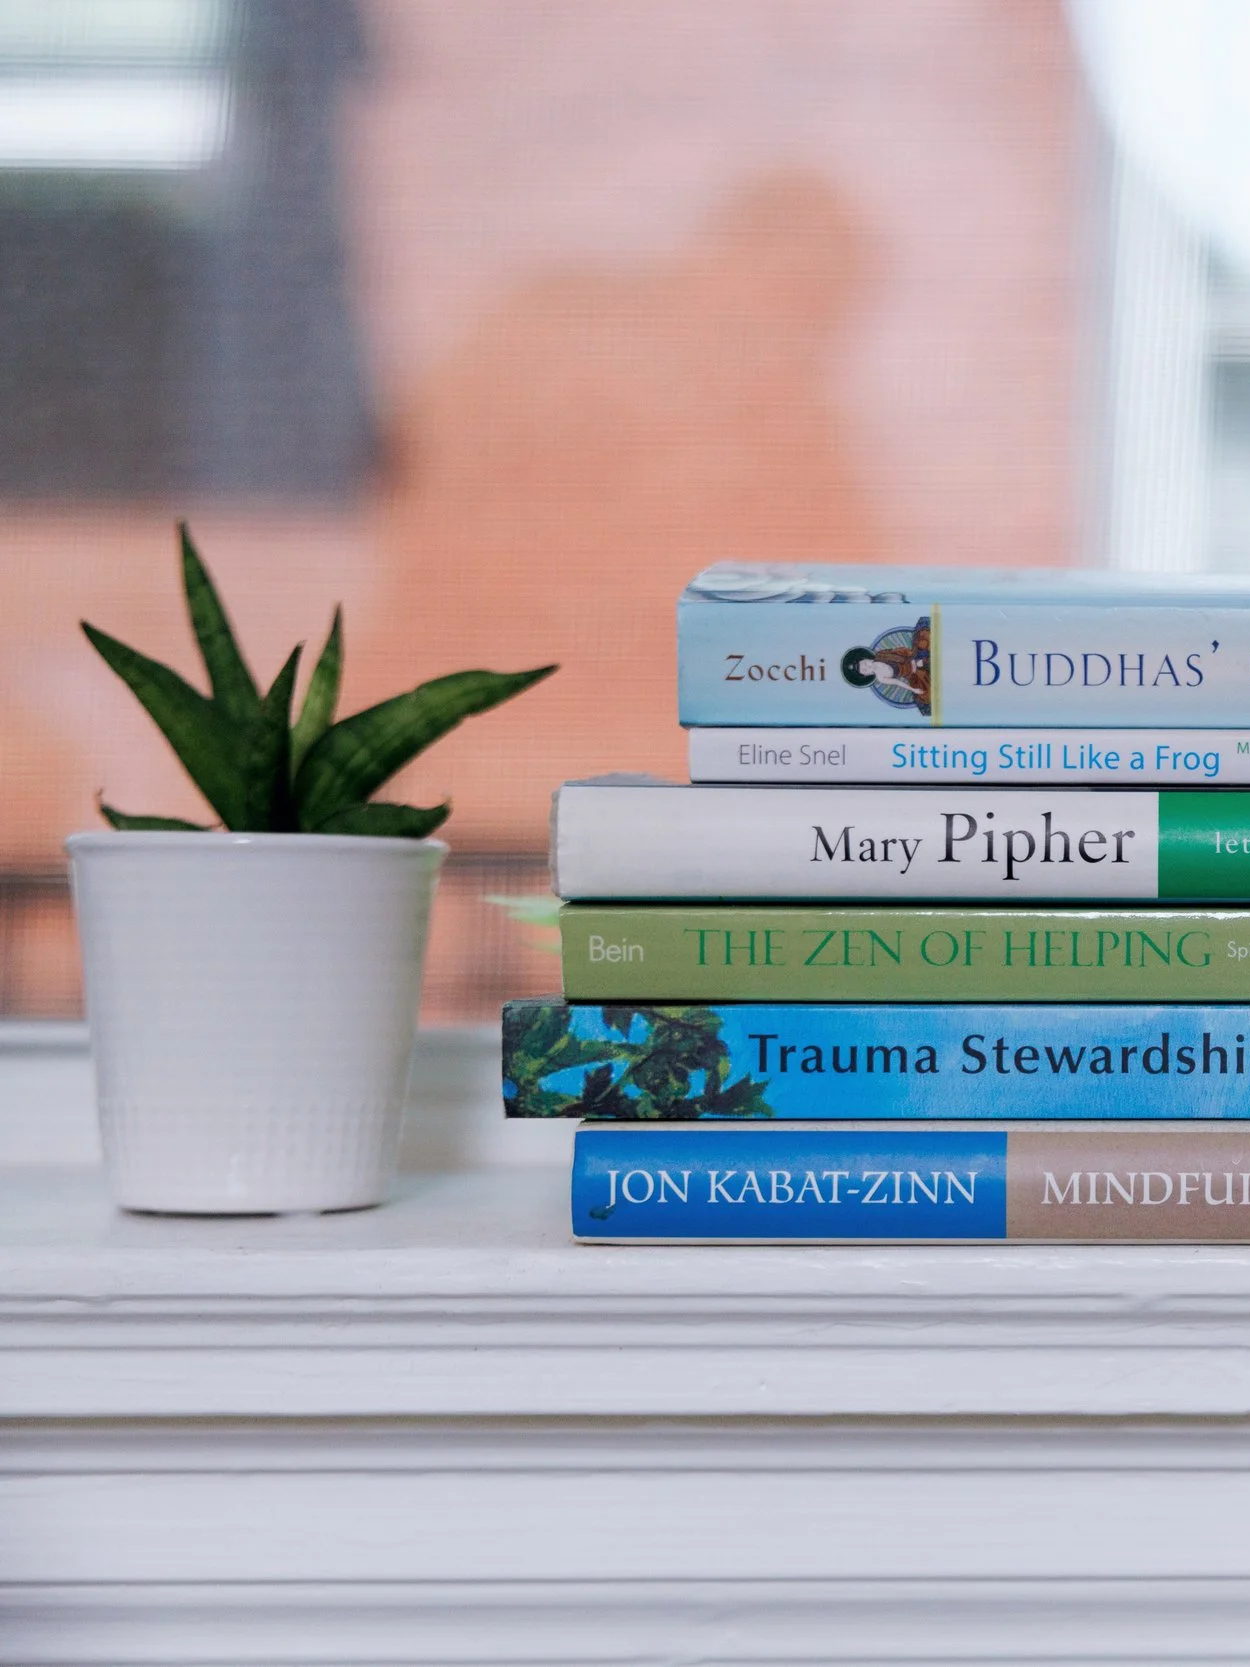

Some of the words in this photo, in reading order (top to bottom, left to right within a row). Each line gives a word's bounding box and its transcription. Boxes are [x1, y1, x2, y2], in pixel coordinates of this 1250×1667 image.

[725, 654, 826, 682] Zocchi
[738, 745, 793, 766] Eline
[800, 745, 846, 766] Snel
[892, 744, 987, 775] Sitting
[999, 744, 1051, 769] Still
[1063, 745, 1119, 769] Like
[1130, 751, 1145, 769] a
[1156, 746, 1220, 776] Frog
[811, 826, 922, 874] Mary
[938, 812, 1134, 880] Pipher
[589, 936, 644, 962] Bein
[683, 929, 786, 967] THE
[804, 930, 904, 967] ZEN
[921, 930, 991, 967] OF
[1004, 930, 1212, 968] HELPING
[748, 1034, 939, 1074] Trauma
[606, 1169, 689, 1209] JON
[707, 1170, 979, 1204] KABAT-ZINN
